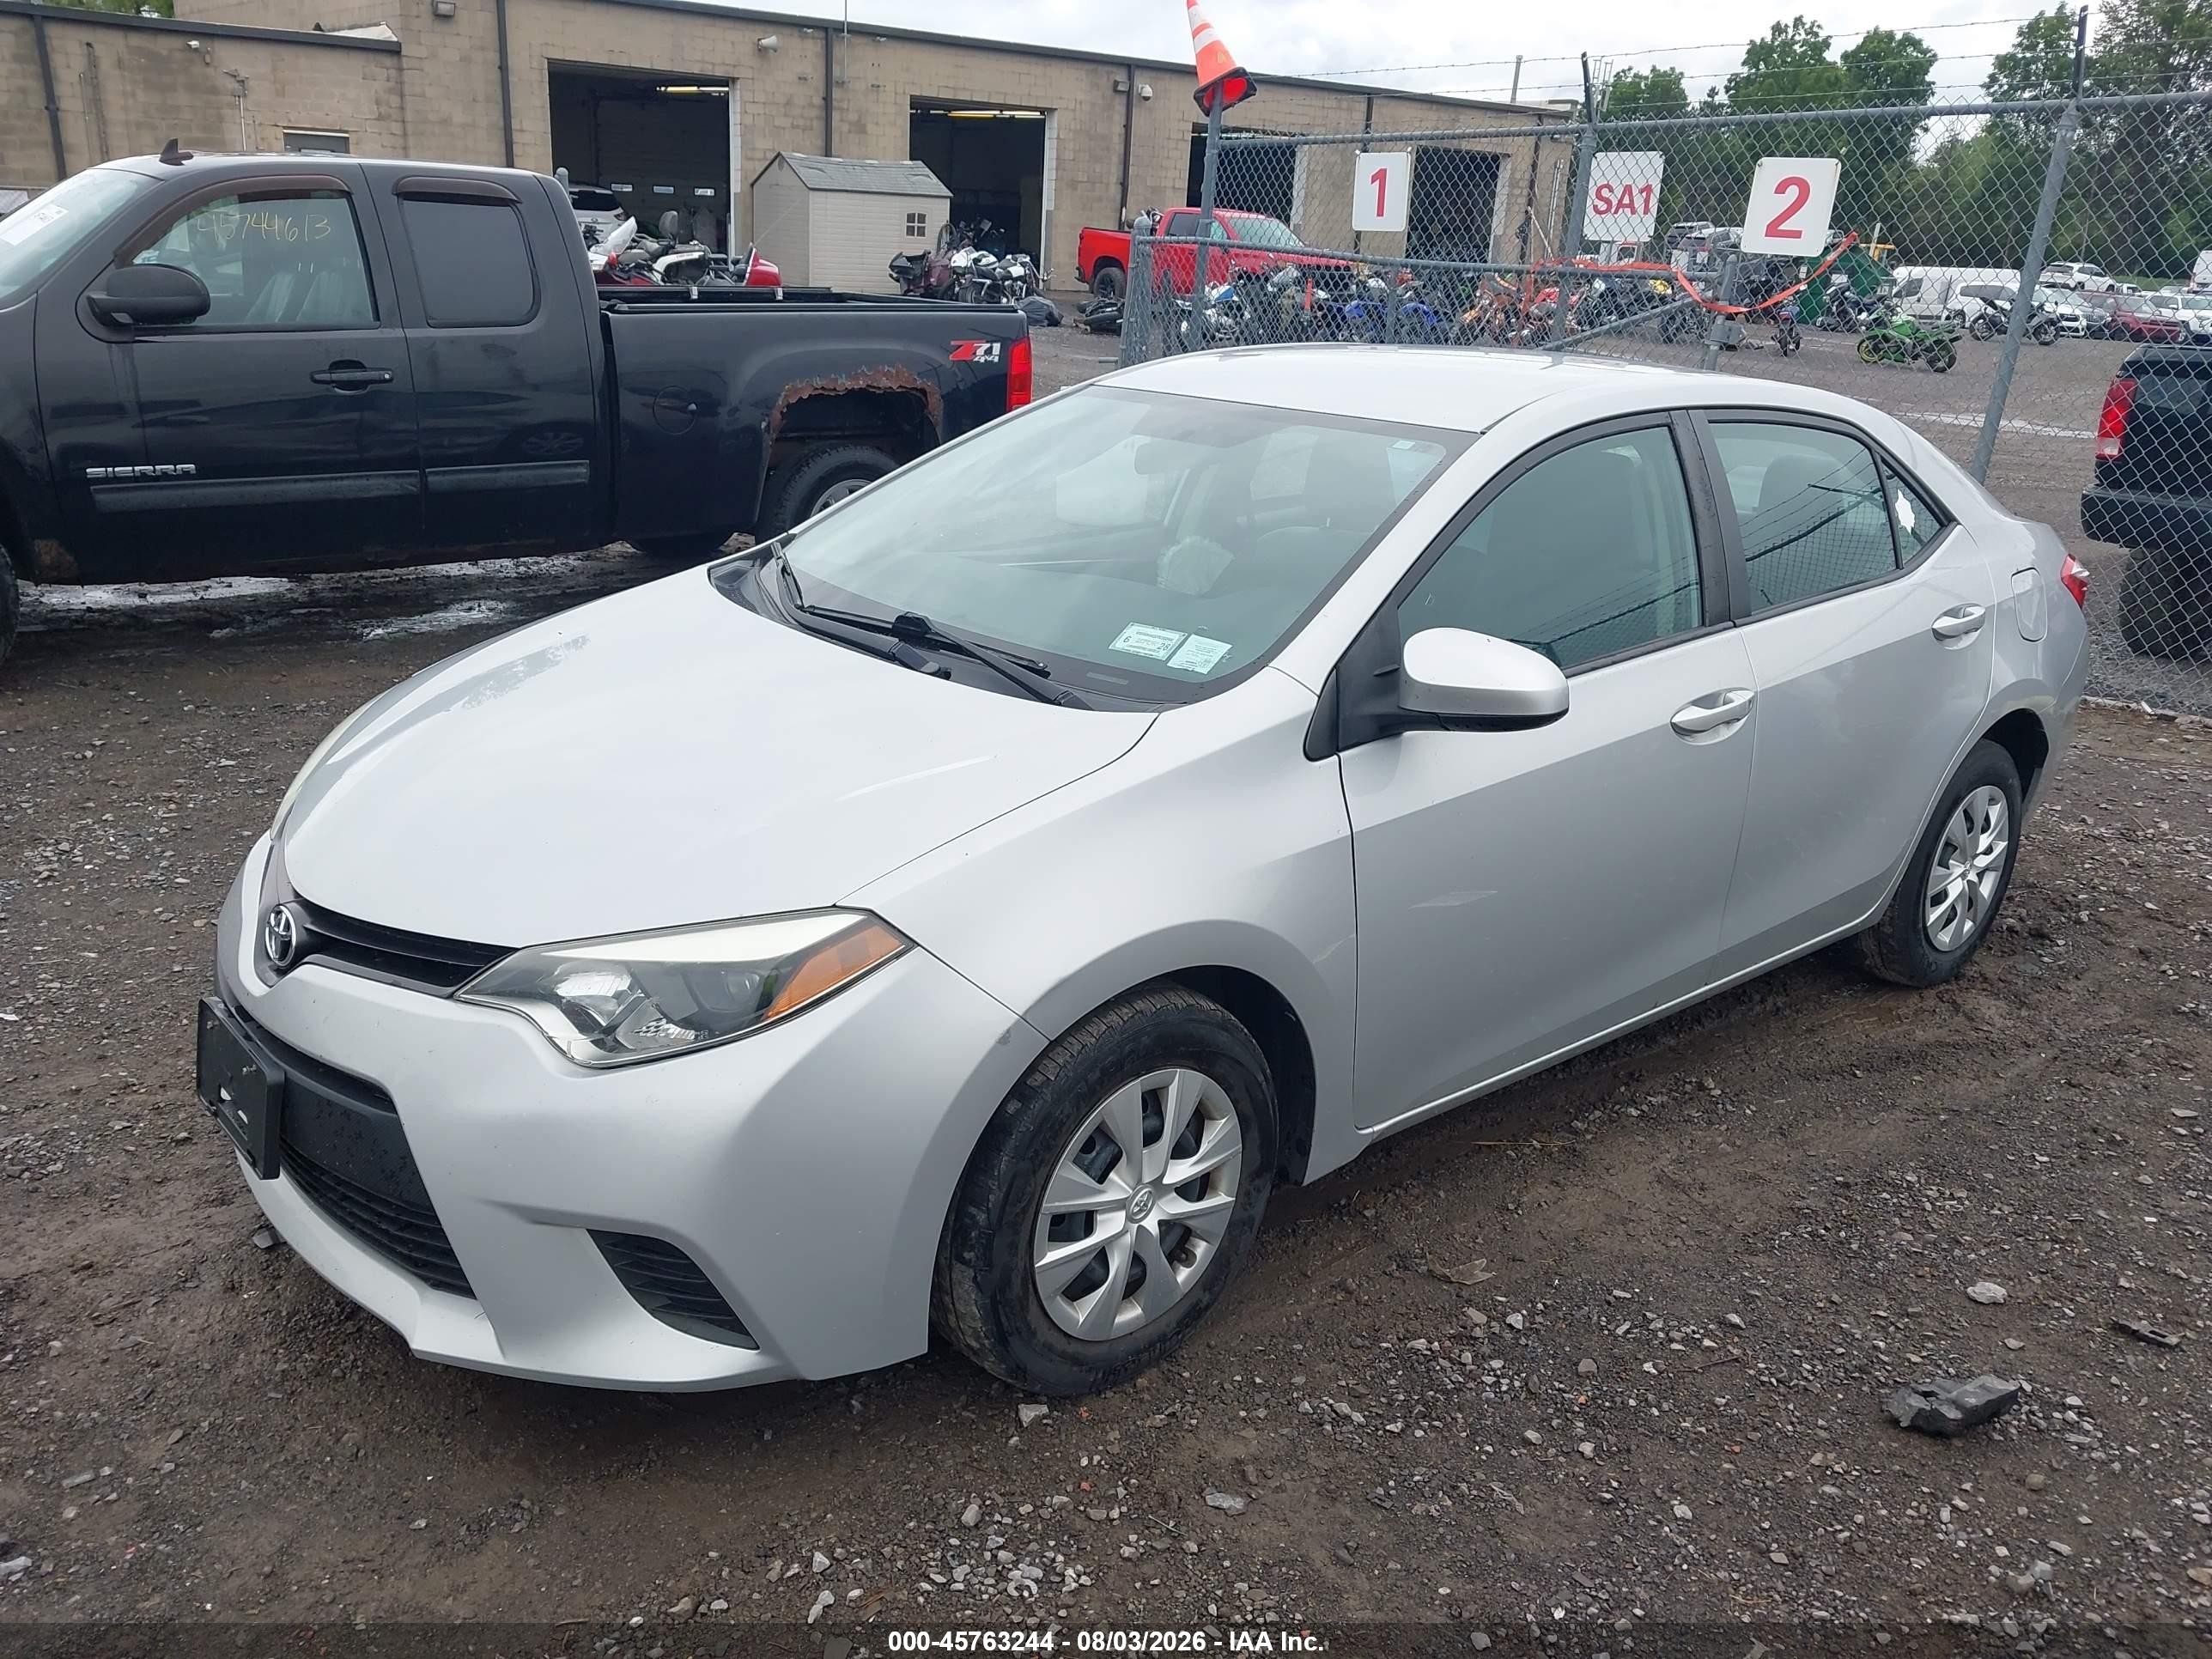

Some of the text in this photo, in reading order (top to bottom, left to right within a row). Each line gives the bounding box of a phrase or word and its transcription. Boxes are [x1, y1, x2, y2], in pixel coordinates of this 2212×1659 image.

[1370, 167, 1388, 217] 1
[1593, 183, 1654, 216] SA1
[1764, 176, 1811, 240] 2
[949, 339, 1001, 361] Z71
[86, 464, 197, 478] SIERRA
